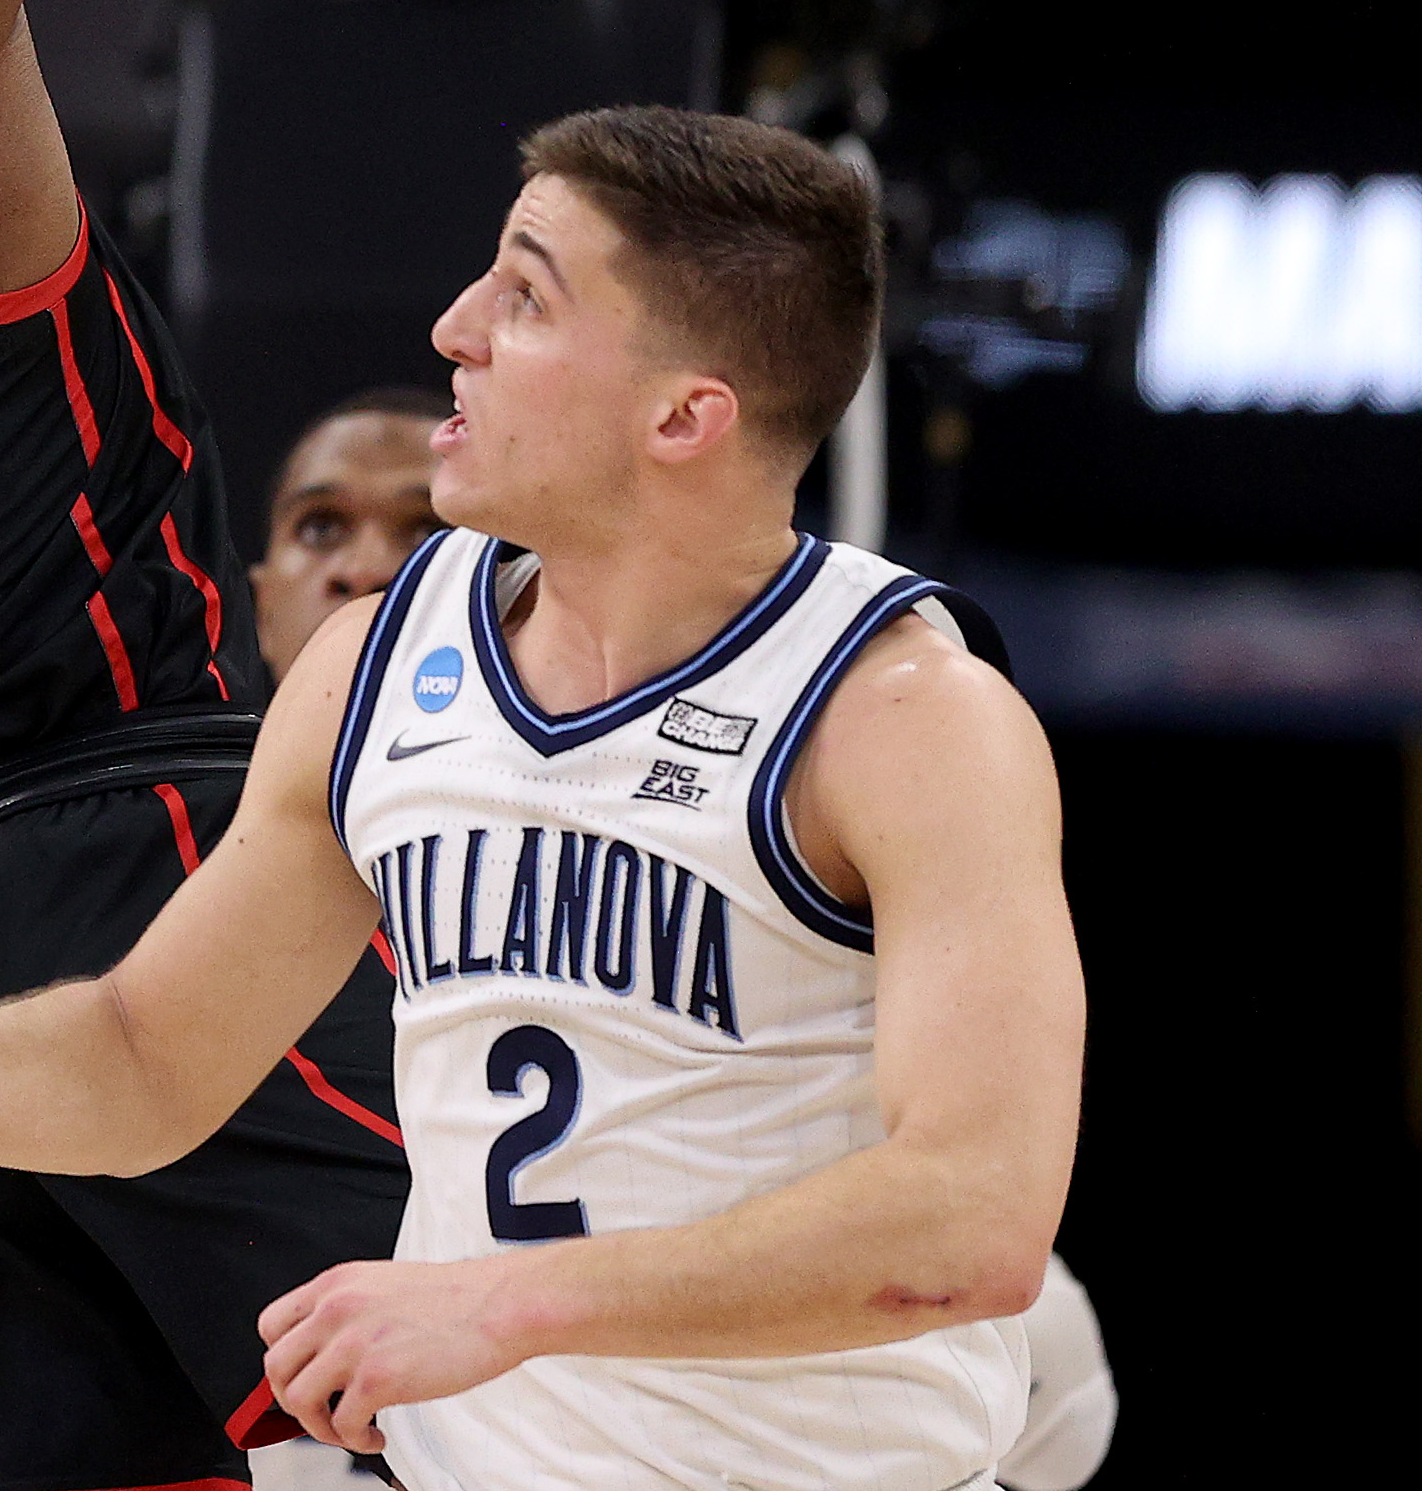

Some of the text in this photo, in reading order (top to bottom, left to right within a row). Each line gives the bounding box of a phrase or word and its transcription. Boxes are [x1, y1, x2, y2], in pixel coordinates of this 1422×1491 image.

[651, 759, 701, 783] BIG
[639, 776, 711, 804] EAST
[485, 1024, 591, 1246] 2
